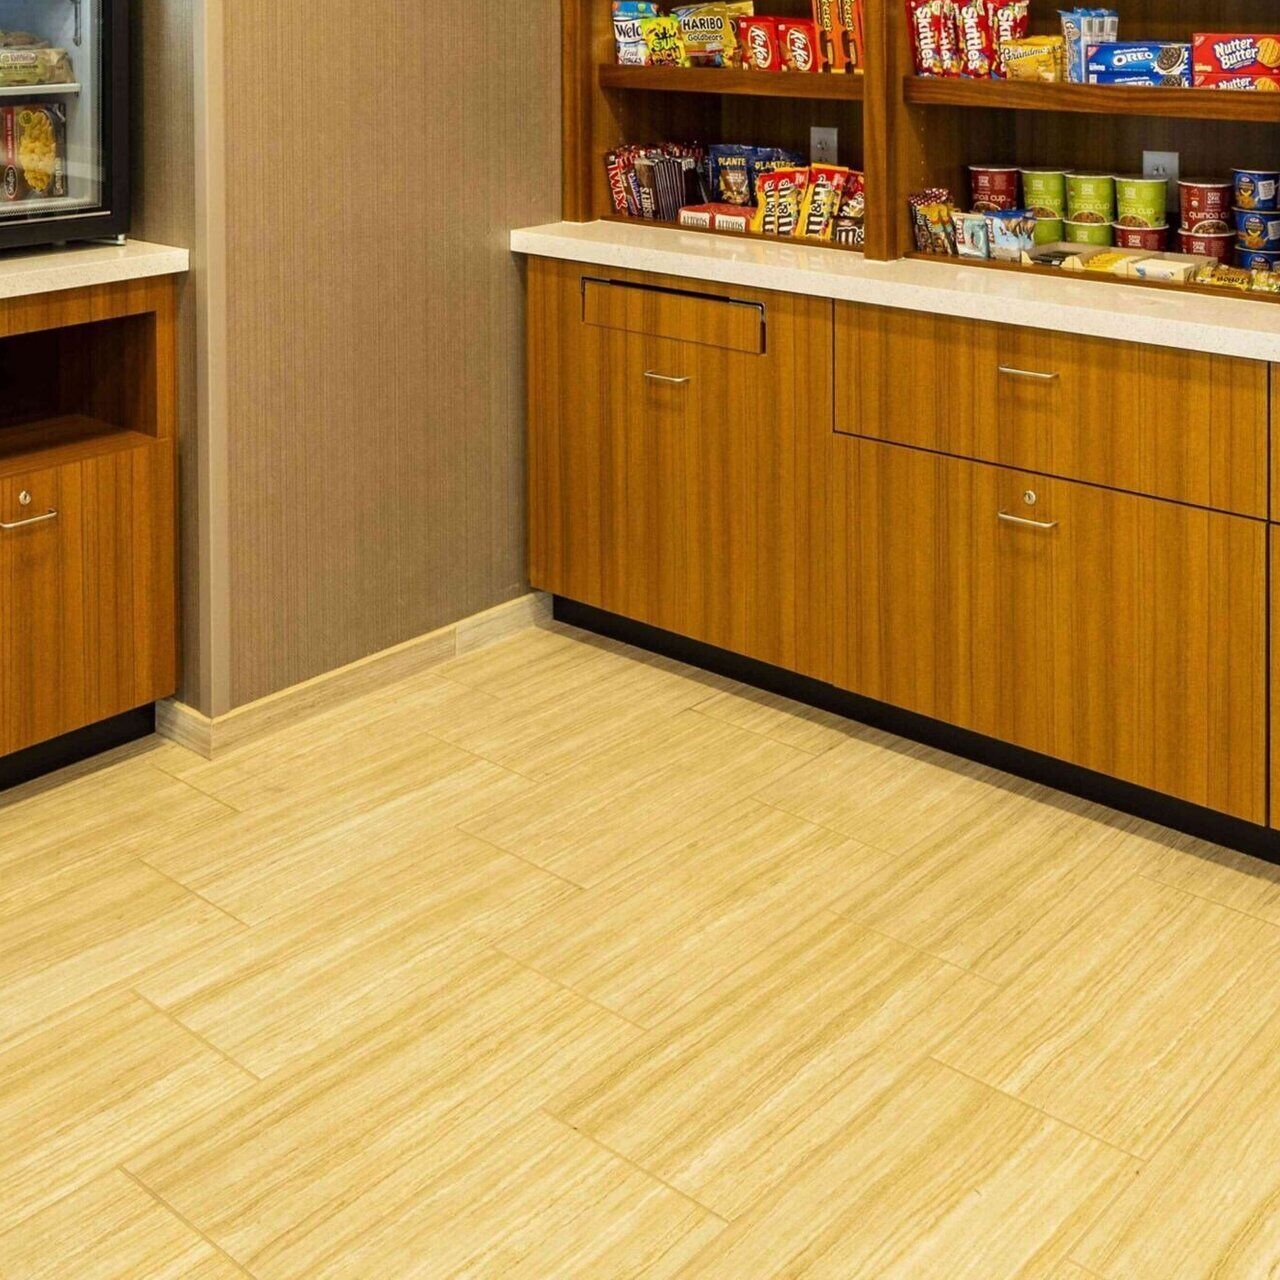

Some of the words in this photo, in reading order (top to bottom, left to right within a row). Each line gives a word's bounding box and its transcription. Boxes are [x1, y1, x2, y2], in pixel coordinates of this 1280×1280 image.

[615, 23, 642, 38] Welc
[682, 17, 723, 31] HARIBO
[687, 33, 724, 42] Goldbears
[917, 7, 934, 67] Skittles
[961, 7, 982, 69] Skittles
[1214, 38, 1253, 56] Nutter
[1113, 51, 1153, 66] OREO
[1220, 49, 1258, 69] Butter
[718, 157, 746, 166] PLANTE
[608, 159, 628, 209] TWIX
[990, 194, 1006, 203] cup
[1189, 211, 1220, 219] quinoa
